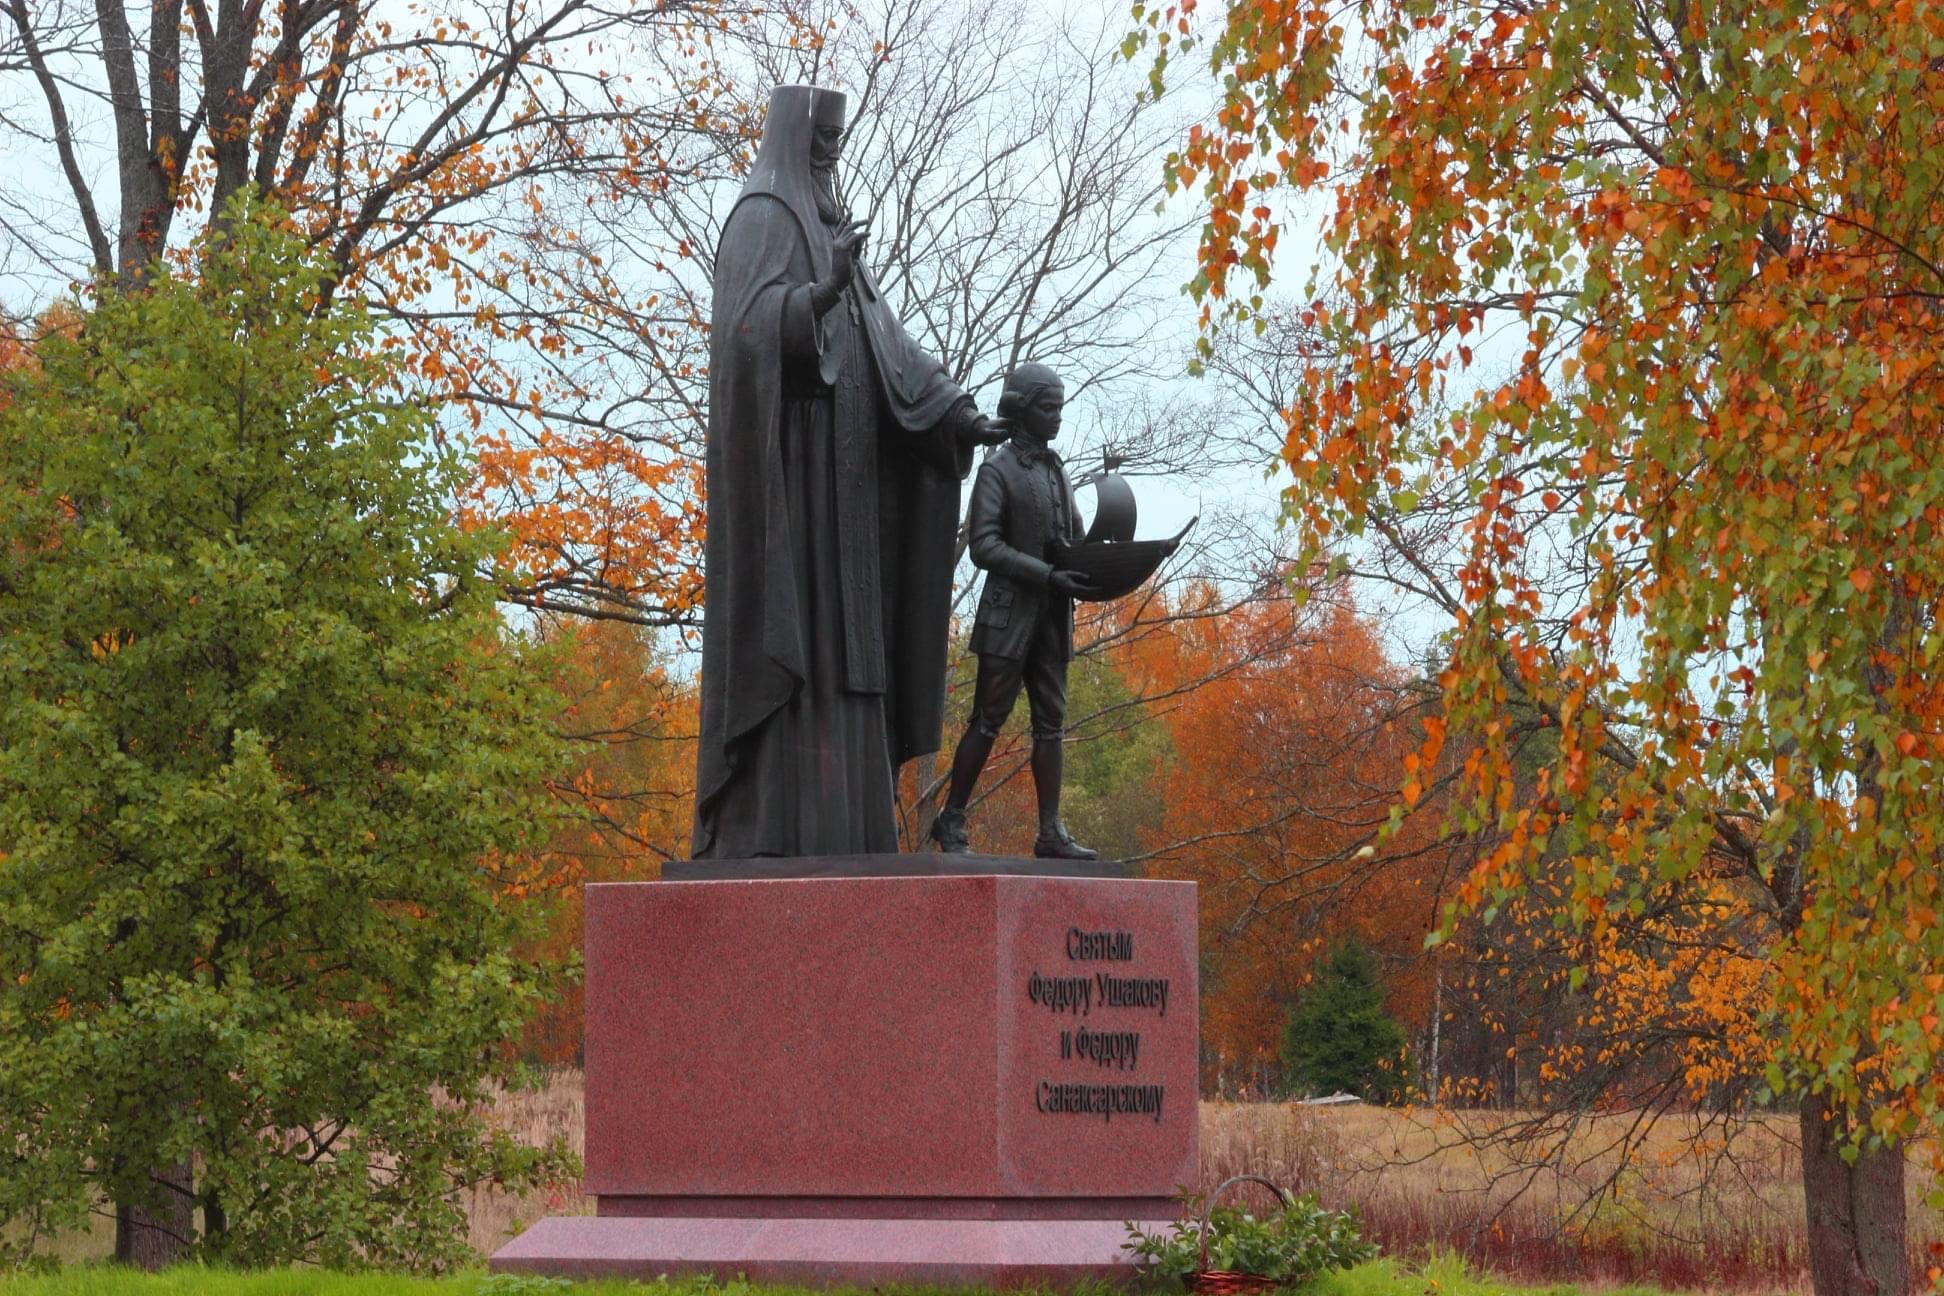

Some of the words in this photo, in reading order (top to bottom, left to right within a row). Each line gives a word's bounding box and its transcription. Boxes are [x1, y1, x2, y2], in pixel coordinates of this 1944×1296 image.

[1067, 927, 1132, 960] Святым
[1028, 972, 1092, 1016] Федору
[1096, 973, 1168, 1017] Ушакову
[1061, 1032, 1071, 1060] и
[1076, 1026, 1140, 1071] Федору
[1036, 1080, 1164, 1123] Санаксарскому
